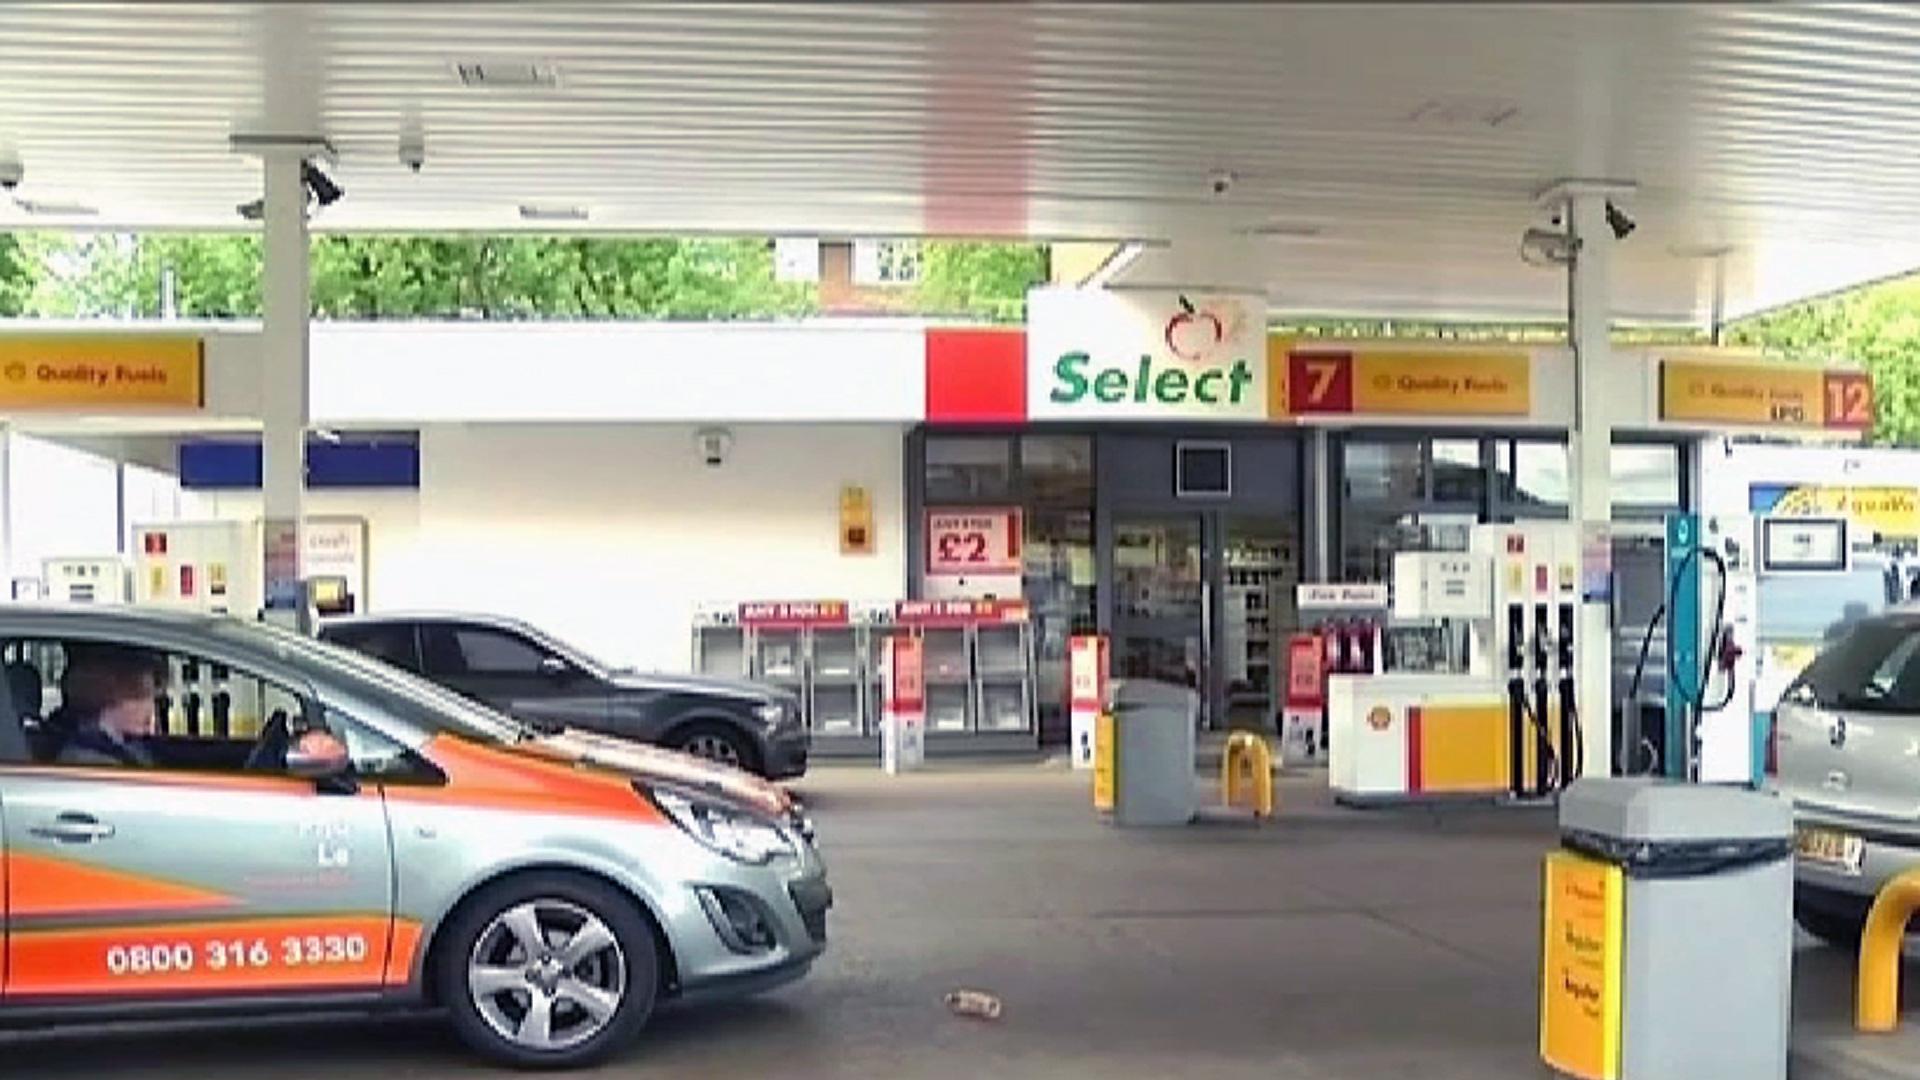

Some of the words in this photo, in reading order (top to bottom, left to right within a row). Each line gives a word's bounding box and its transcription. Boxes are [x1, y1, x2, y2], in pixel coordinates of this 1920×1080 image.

[36, 363, 108, 387] Quality
[1050, 351, 1252, 403] Select
[1305, 361, 1338, 404] 7
[1827, 381, 1870, 422] 12
[938, 532, 986, 562] £2
[107, 944, 194, 975] 0800
[206, 938, 269, 970] 316
[282, 935, 367, 966] 3330
